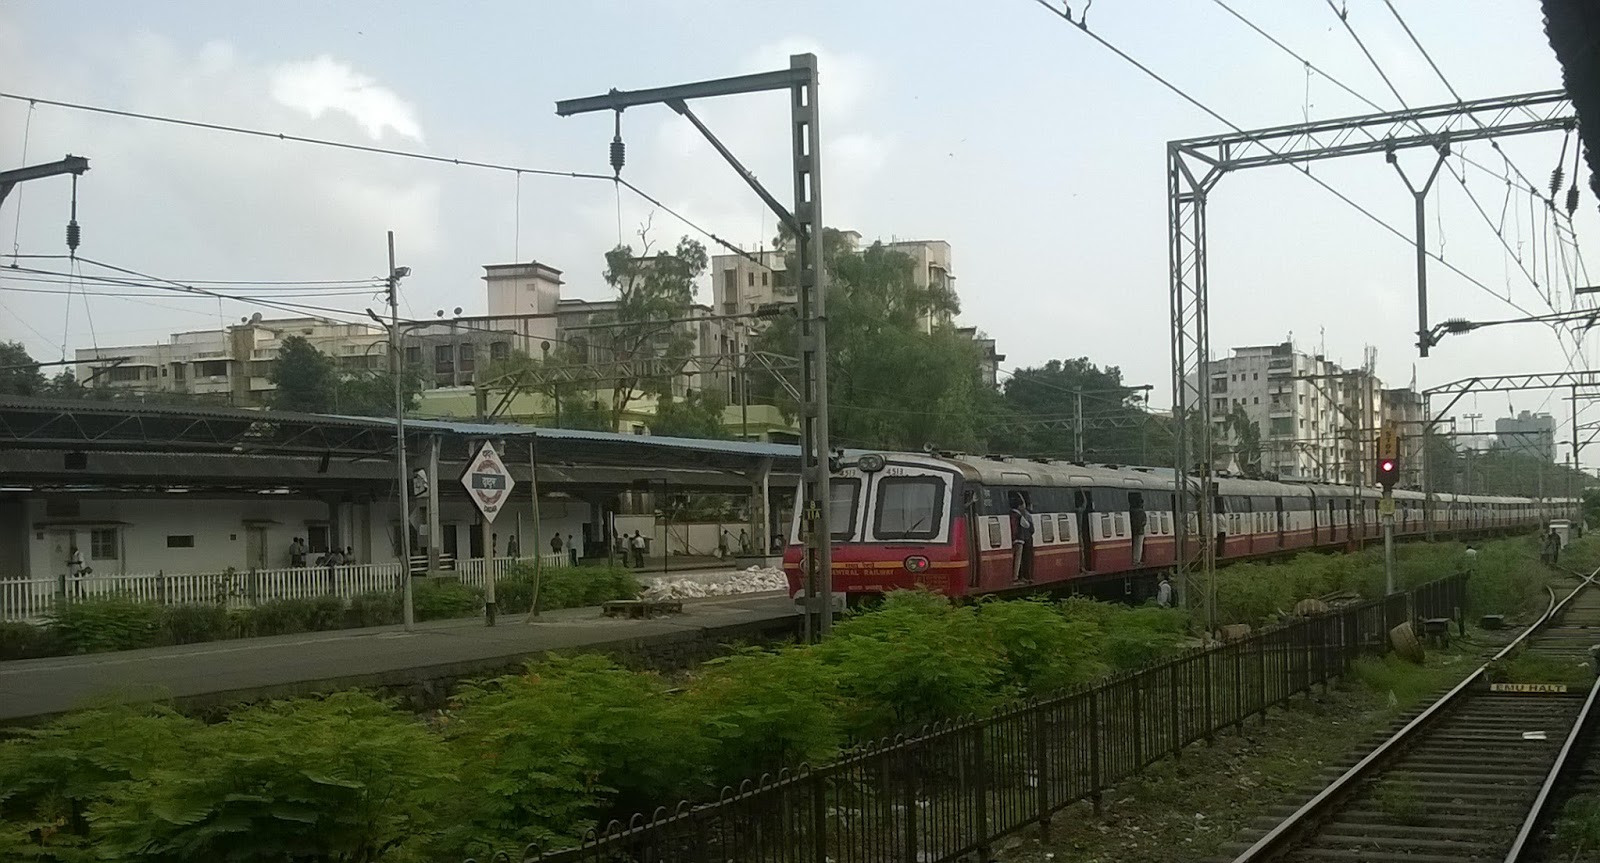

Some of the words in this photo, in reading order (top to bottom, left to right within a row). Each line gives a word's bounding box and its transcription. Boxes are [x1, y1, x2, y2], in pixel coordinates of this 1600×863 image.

[839, 469, 856, 477] 4513
[810, 501, 816, 509] 8
[1528, 684, 1563, 692] HALT
